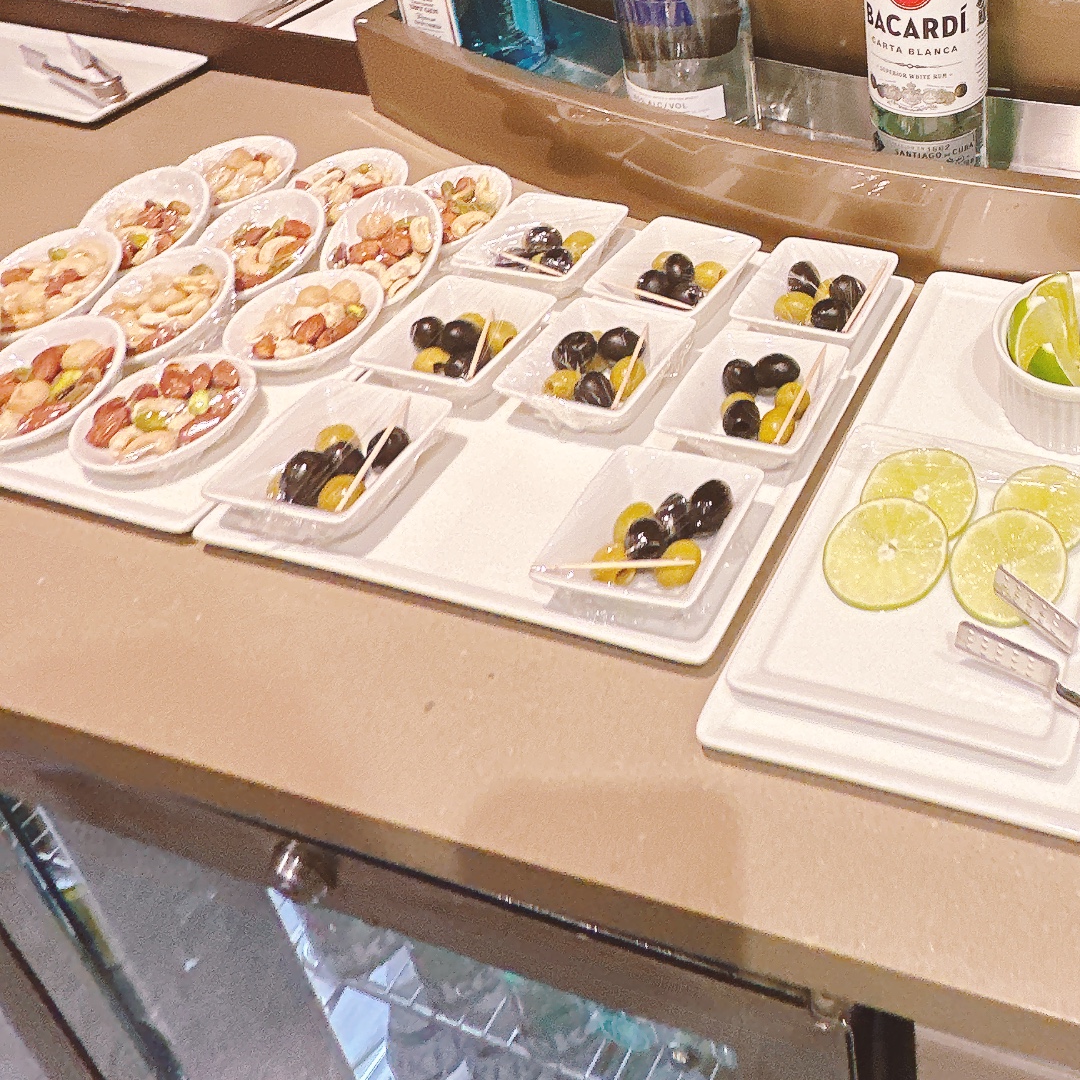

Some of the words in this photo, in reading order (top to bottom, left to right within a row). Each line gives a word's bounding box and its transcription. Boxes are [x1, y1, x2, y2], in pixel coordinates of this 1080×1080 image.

[866, 1, 967, 39] BACARDÍ
[871, 35, 903, 54] CARTA
[908, 45, 959, 56] BLANCA
[894, 147, 942, 159] SANTIAGO
[952, 141, 974, 156] CUBA
